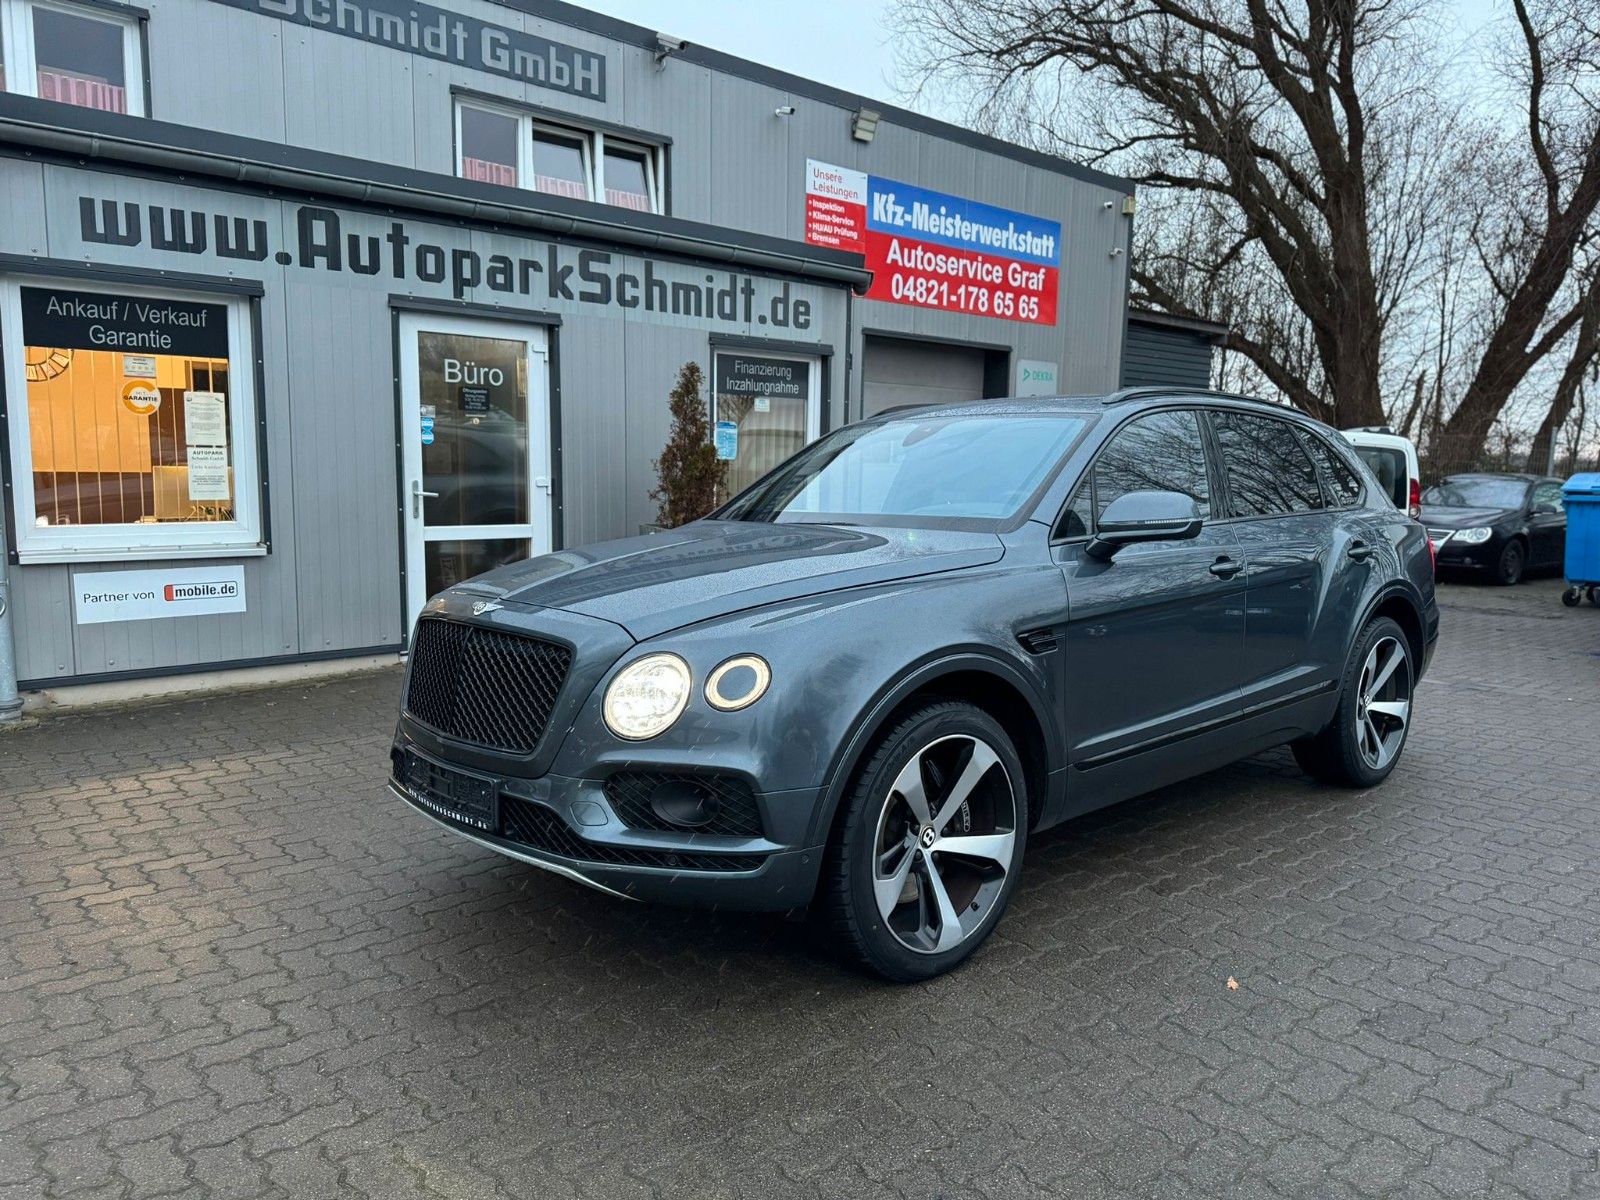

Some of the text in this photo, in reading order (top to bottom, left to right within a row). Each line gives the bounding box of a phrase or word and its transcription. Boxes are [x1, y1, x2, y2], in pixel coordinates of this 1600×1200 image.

[481, 26, 600, 95] GmbH
[813, 167, 843, 183] Unsere
[813, 180, 859, 199] Leistungen
[812, 199, 846, 214] Inspektion
[812, 210, 855, 226] Klima-Service
[873, 192, 1055, 259] Kfz-Meisterwerkstatt
[812, 222, 858, 240] HU/AU Prüfung
[812, 231, 840, 245] Bremsen
[79, 197, 811, 330] www.AutoparkSchmidt.de
[886, 238, 1045, 291] Autoservice Graf
[891, 273, 1039, 320] 04821-178 65 65
[47, 296, 208, 328] Ankauf / Verkauf
[89, 325, 172, 349] Garantie
[444, 358, 504, 386] Büro
[734, 360, 792, 380] Finanzierung
[726, 376, 800, 395] Inzahlungnahme
[83, 583, 235, 604] Partner von mobile.de
